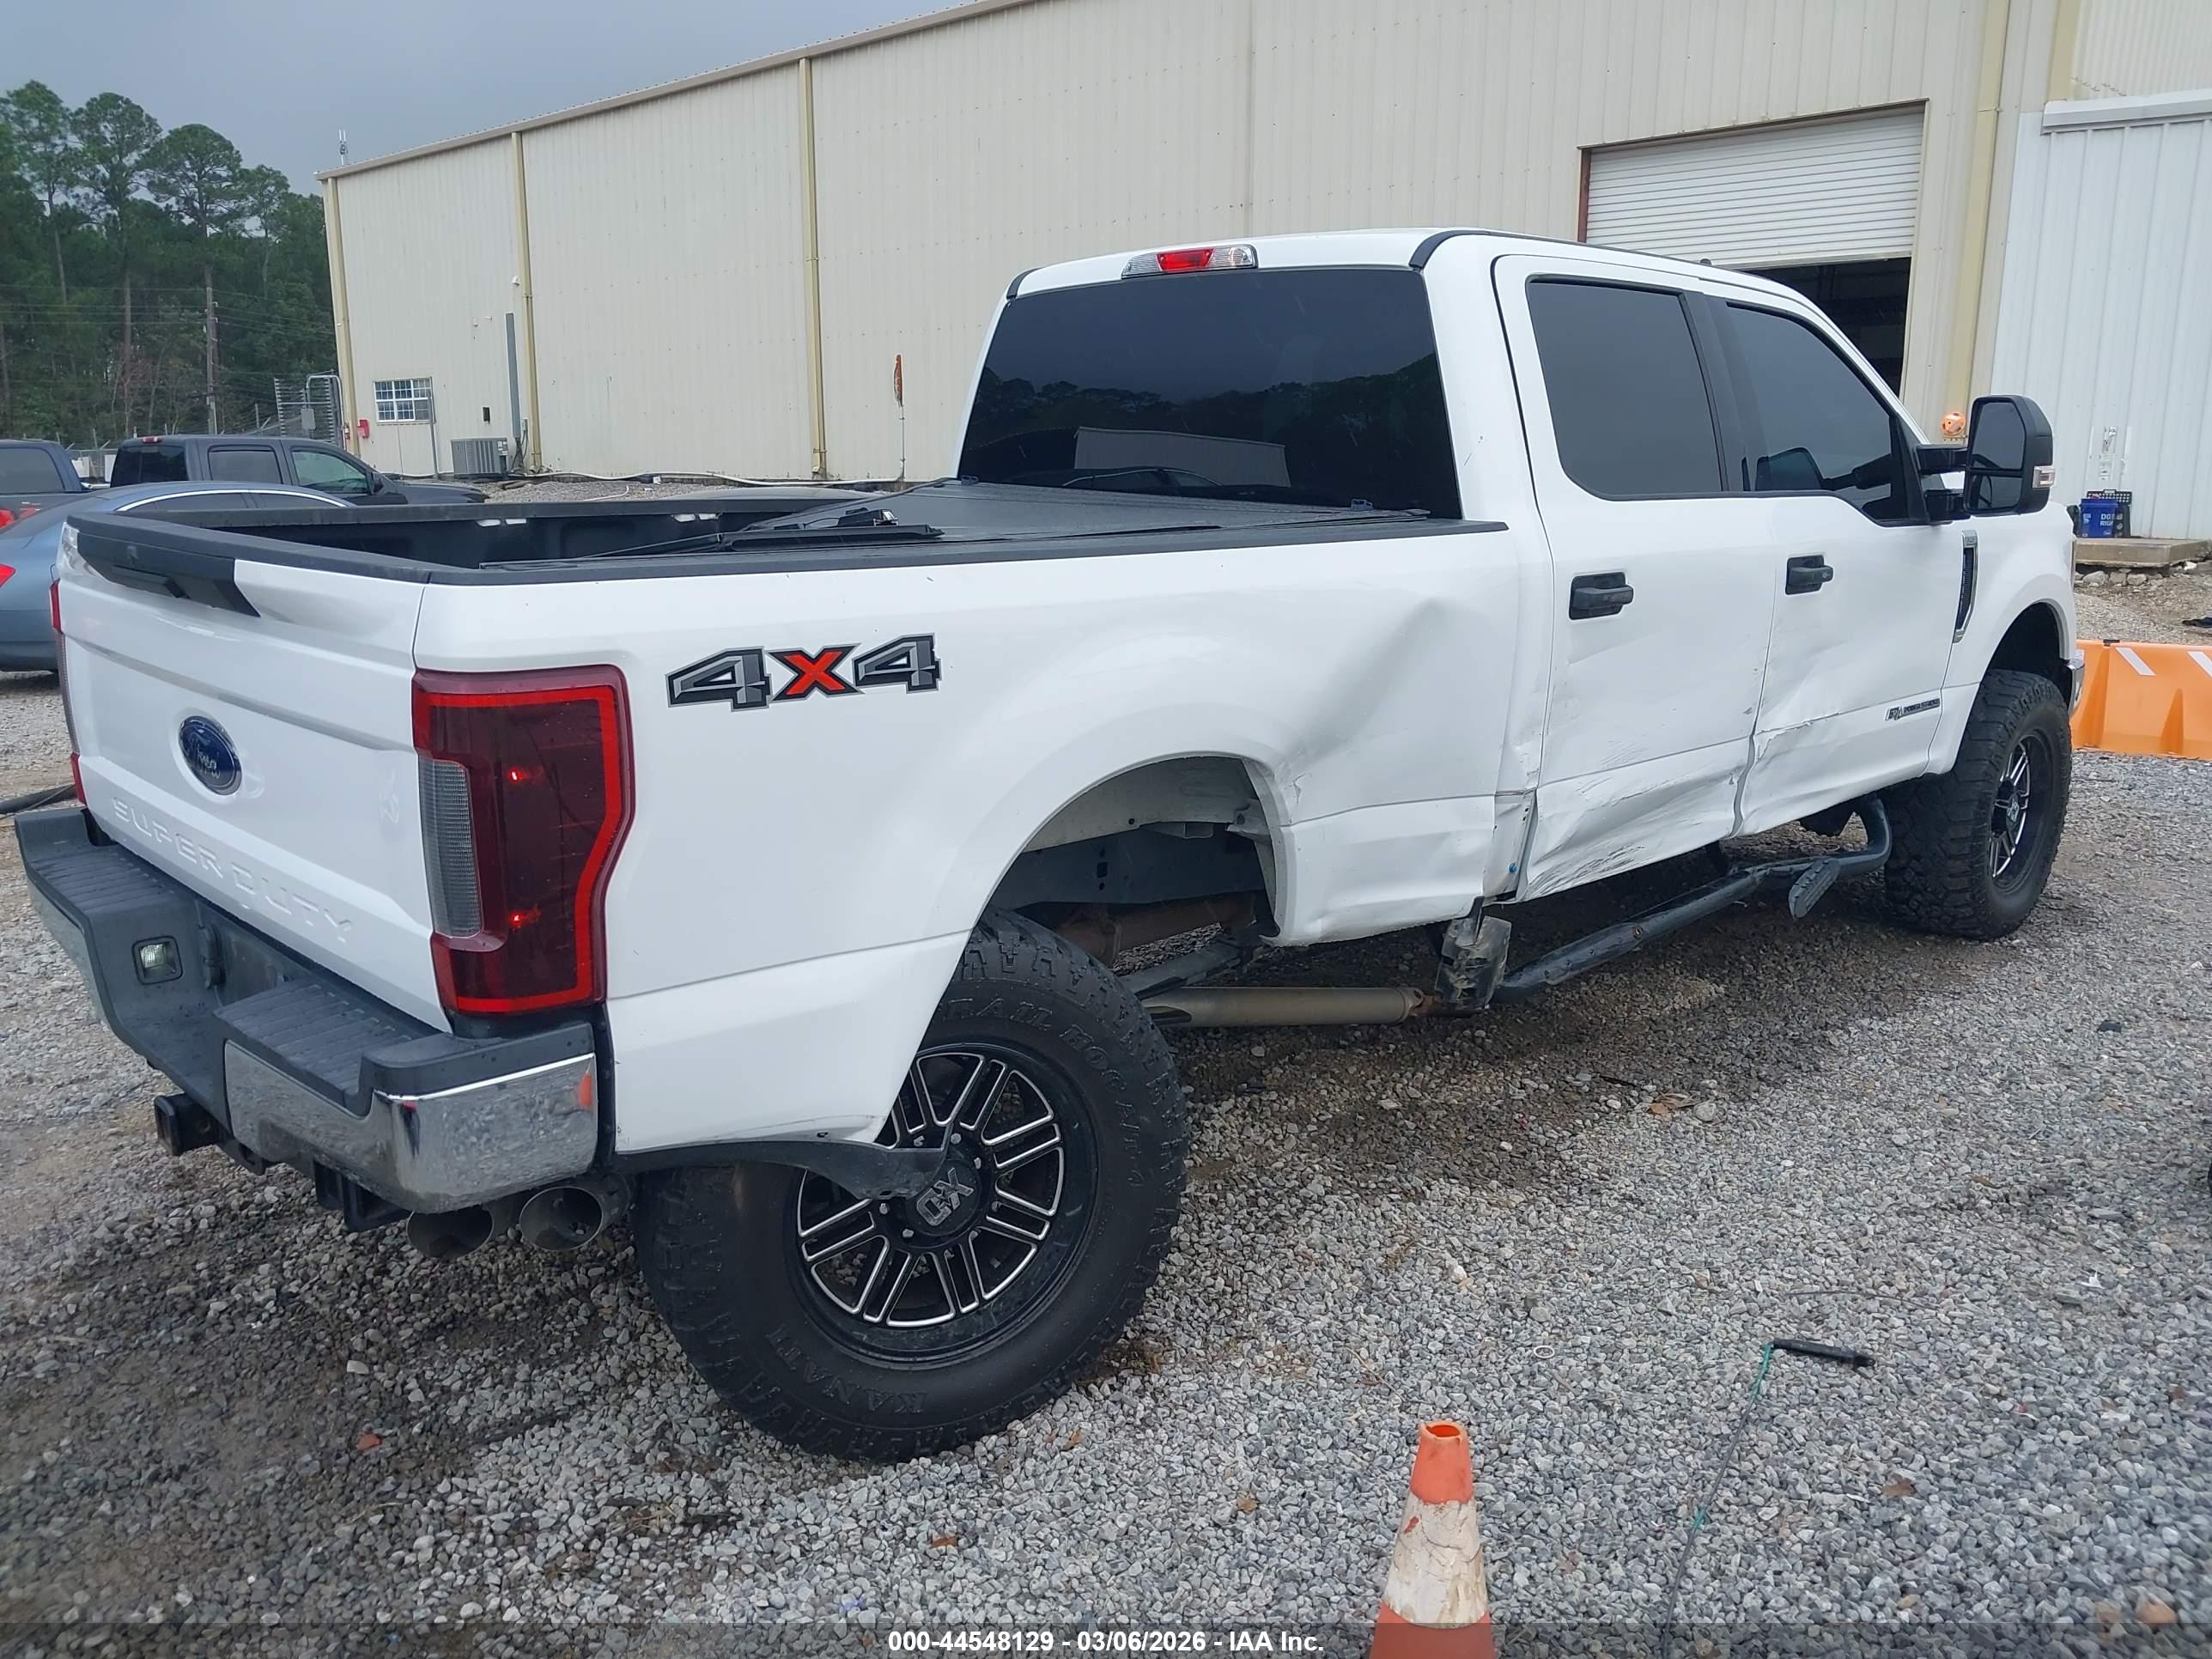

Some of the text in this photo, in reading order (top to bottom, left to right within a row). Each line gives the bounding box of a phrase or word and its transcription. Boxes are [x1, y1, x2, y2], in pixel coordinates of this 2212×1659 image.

[665, 632, 941, 712] 4X4
[111, 796, 354, 944] SUPER DUTY
[940, 996, 1054, 1030] RAIL
